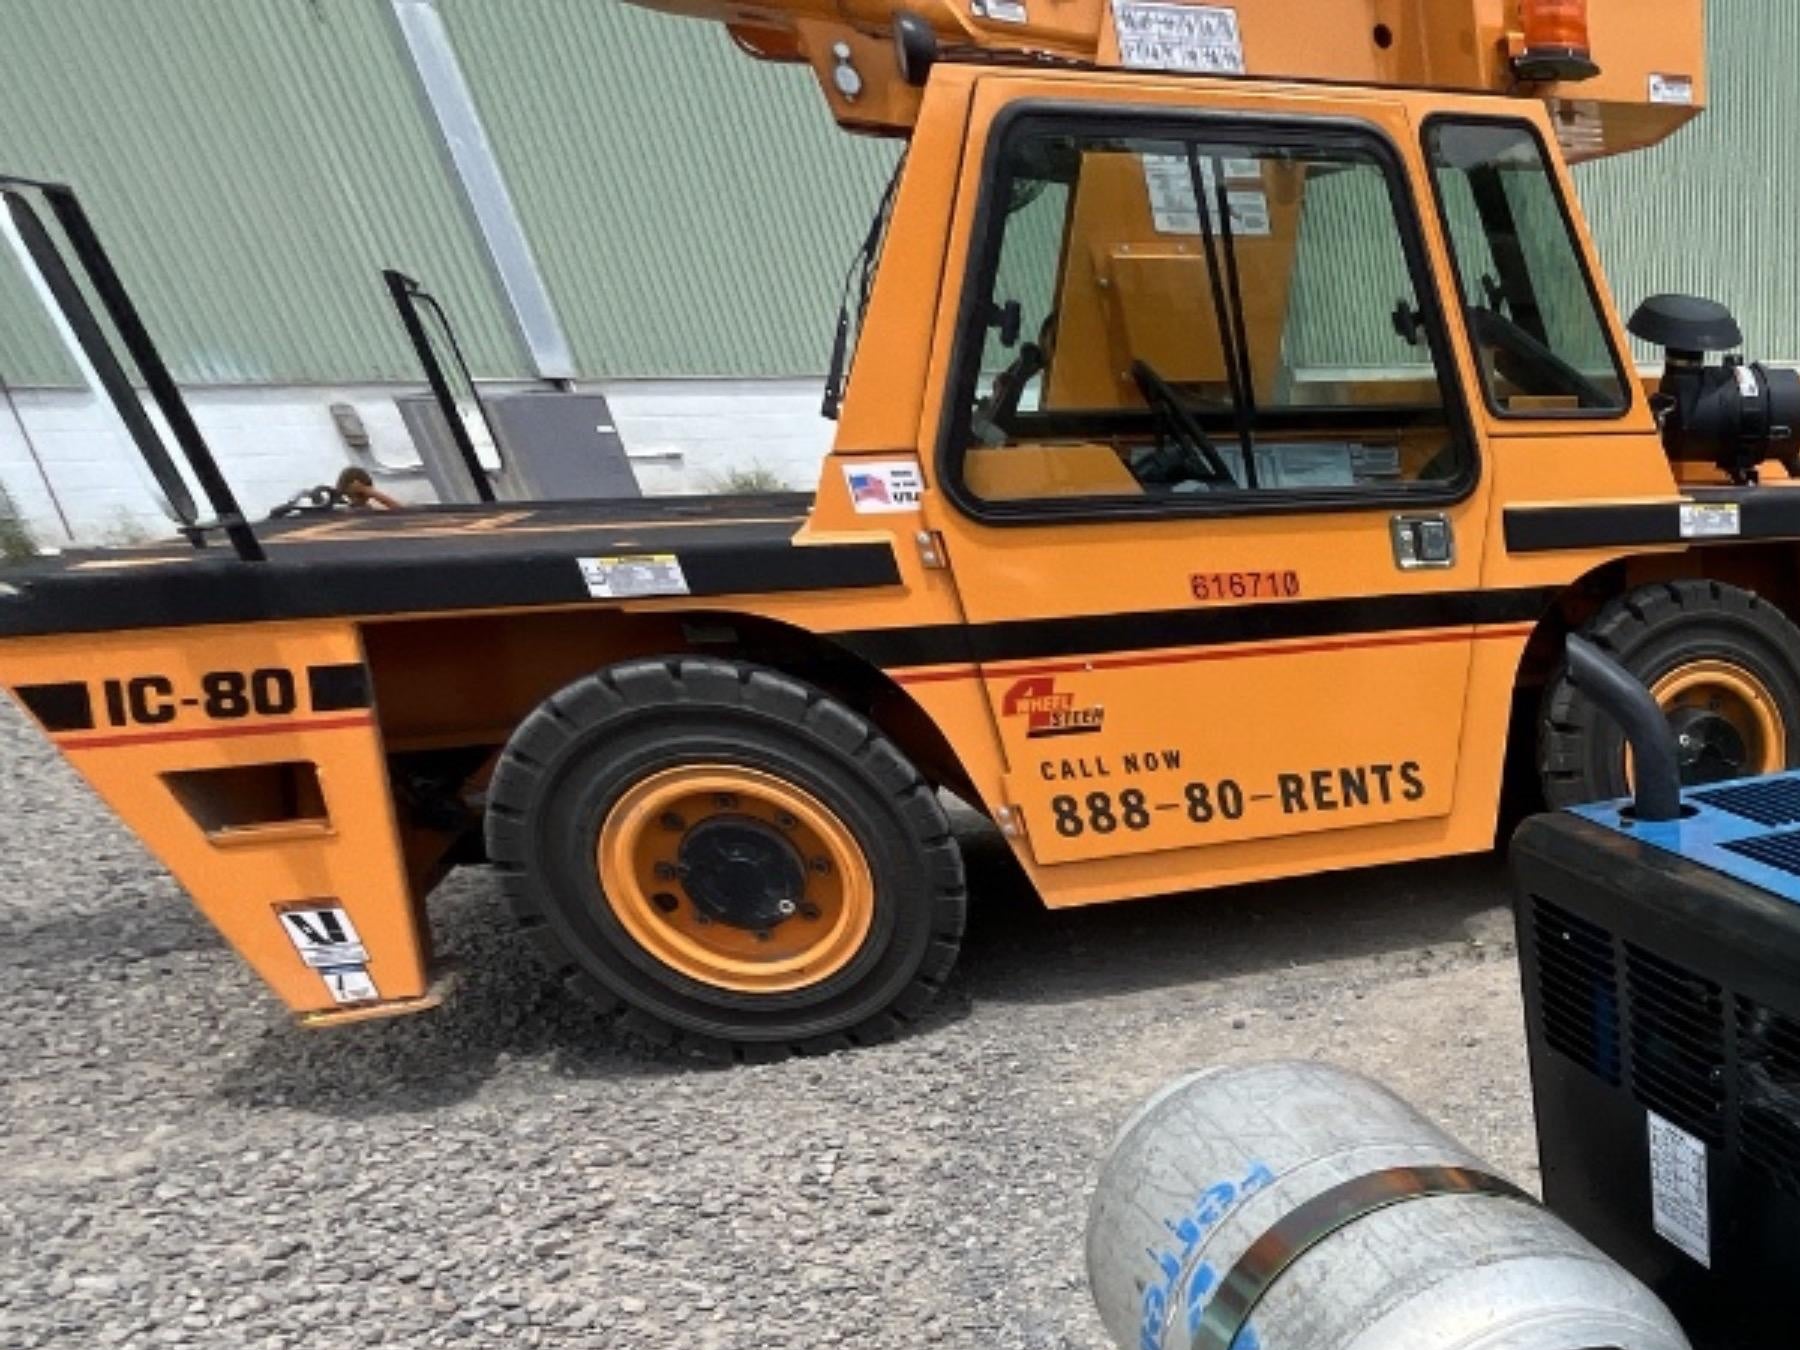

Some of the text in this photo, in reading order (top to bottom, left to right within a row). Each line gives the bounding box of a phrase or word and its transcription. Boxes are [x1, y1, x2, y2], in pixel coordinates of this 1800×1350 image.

[1191, 570, 1300, 600] 616710
[104, 668, 298, 727] IC-80
[1040, 750, 1182, 782] CALL NOW
[1051, 761, 1426, 838] 888-80-RENTS
